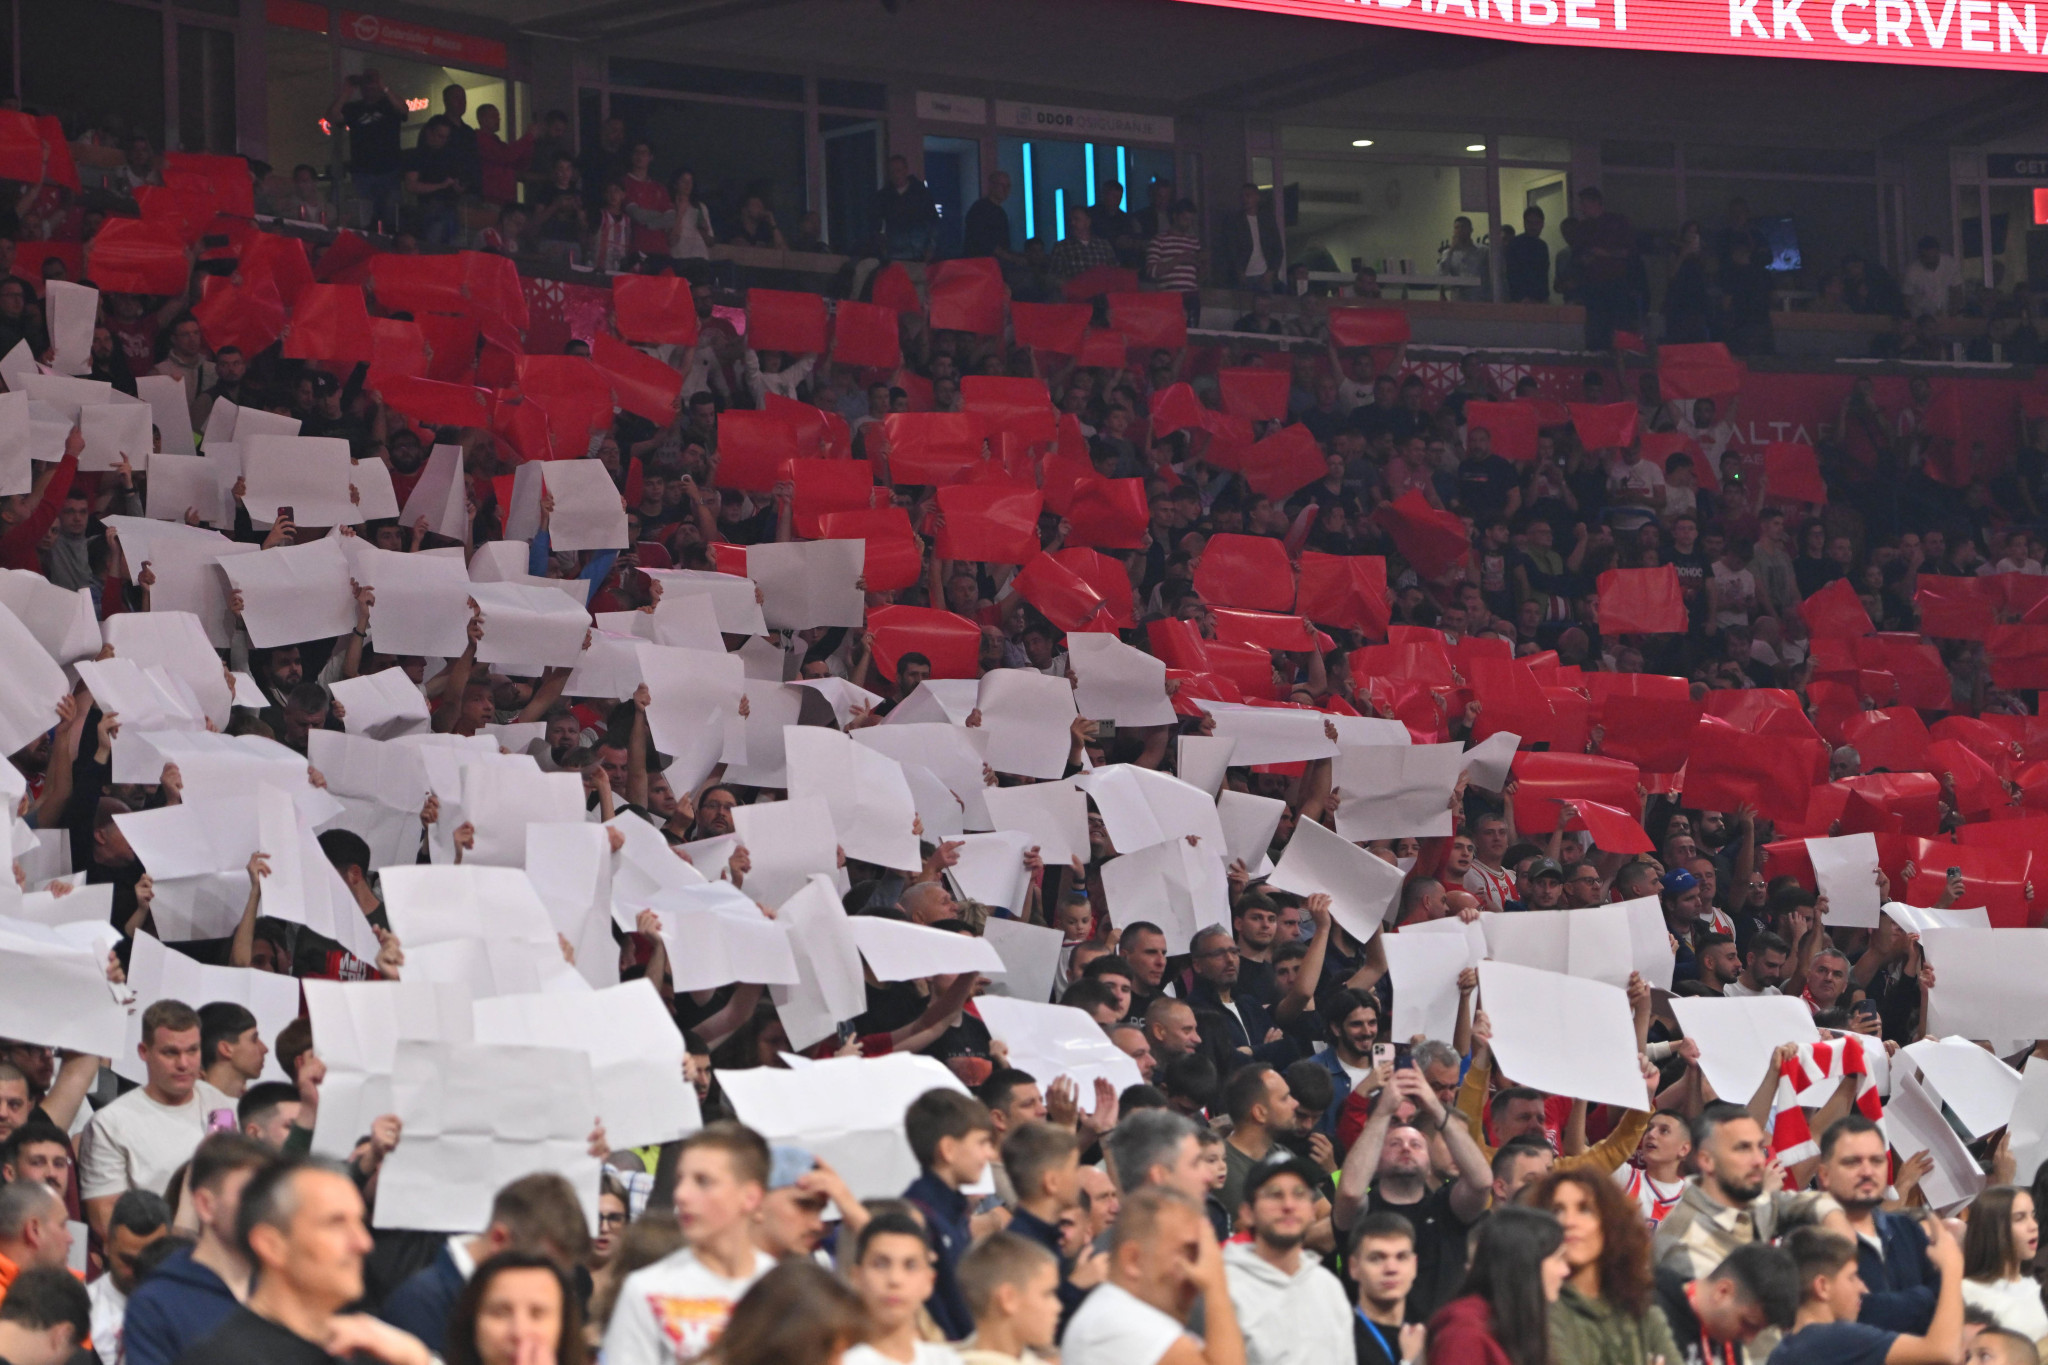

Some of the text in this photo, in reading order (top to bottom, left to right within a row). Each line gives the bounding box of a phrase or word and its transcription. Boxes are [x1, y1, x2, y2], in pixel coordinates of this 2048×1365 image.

[1729, 0, 1814, 41] KK
[1831, 0, 2048, 55] CRVEN
[1037, 112, 1074, 126] DDOR
